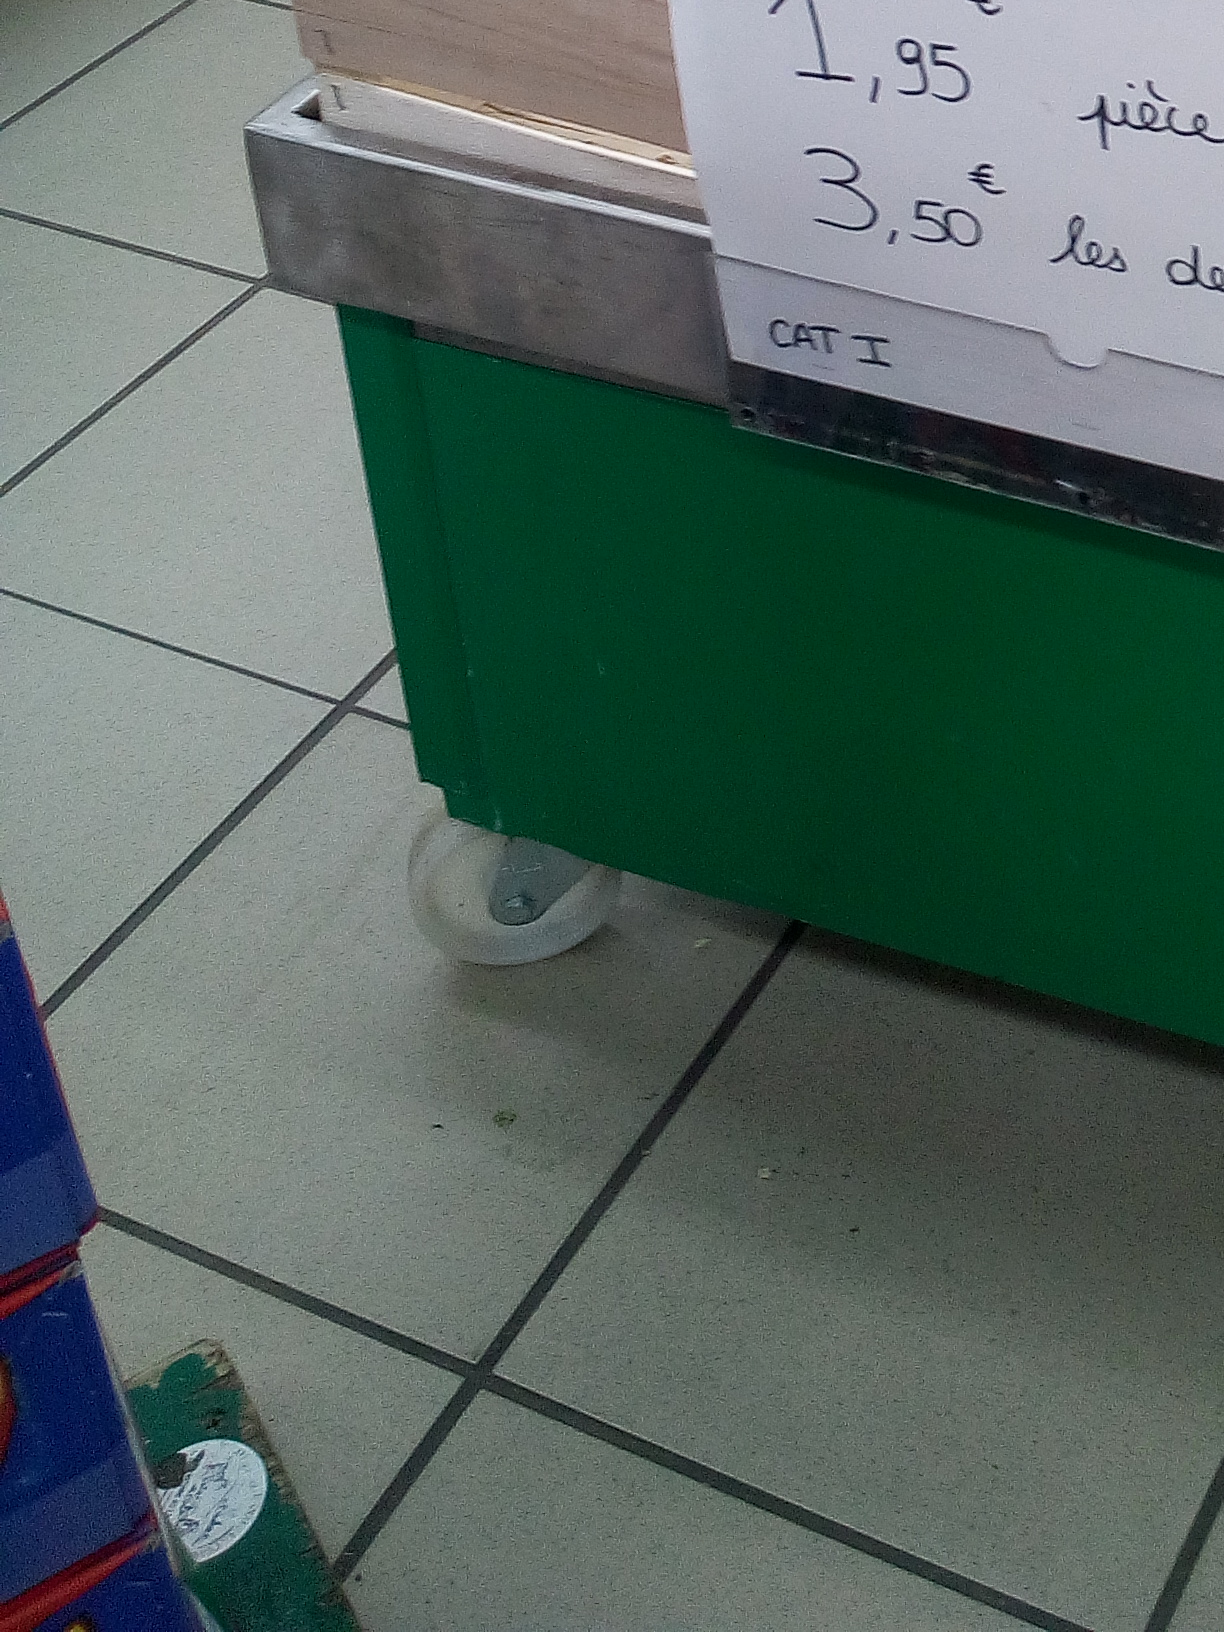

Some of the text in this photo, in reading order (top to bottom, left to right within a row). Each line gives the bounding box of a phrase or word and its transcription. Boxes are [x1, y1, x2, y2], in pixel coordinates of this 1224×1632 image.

[1049, 215, 1128, 273] les
[768, 318, 892, 368] CAT I
